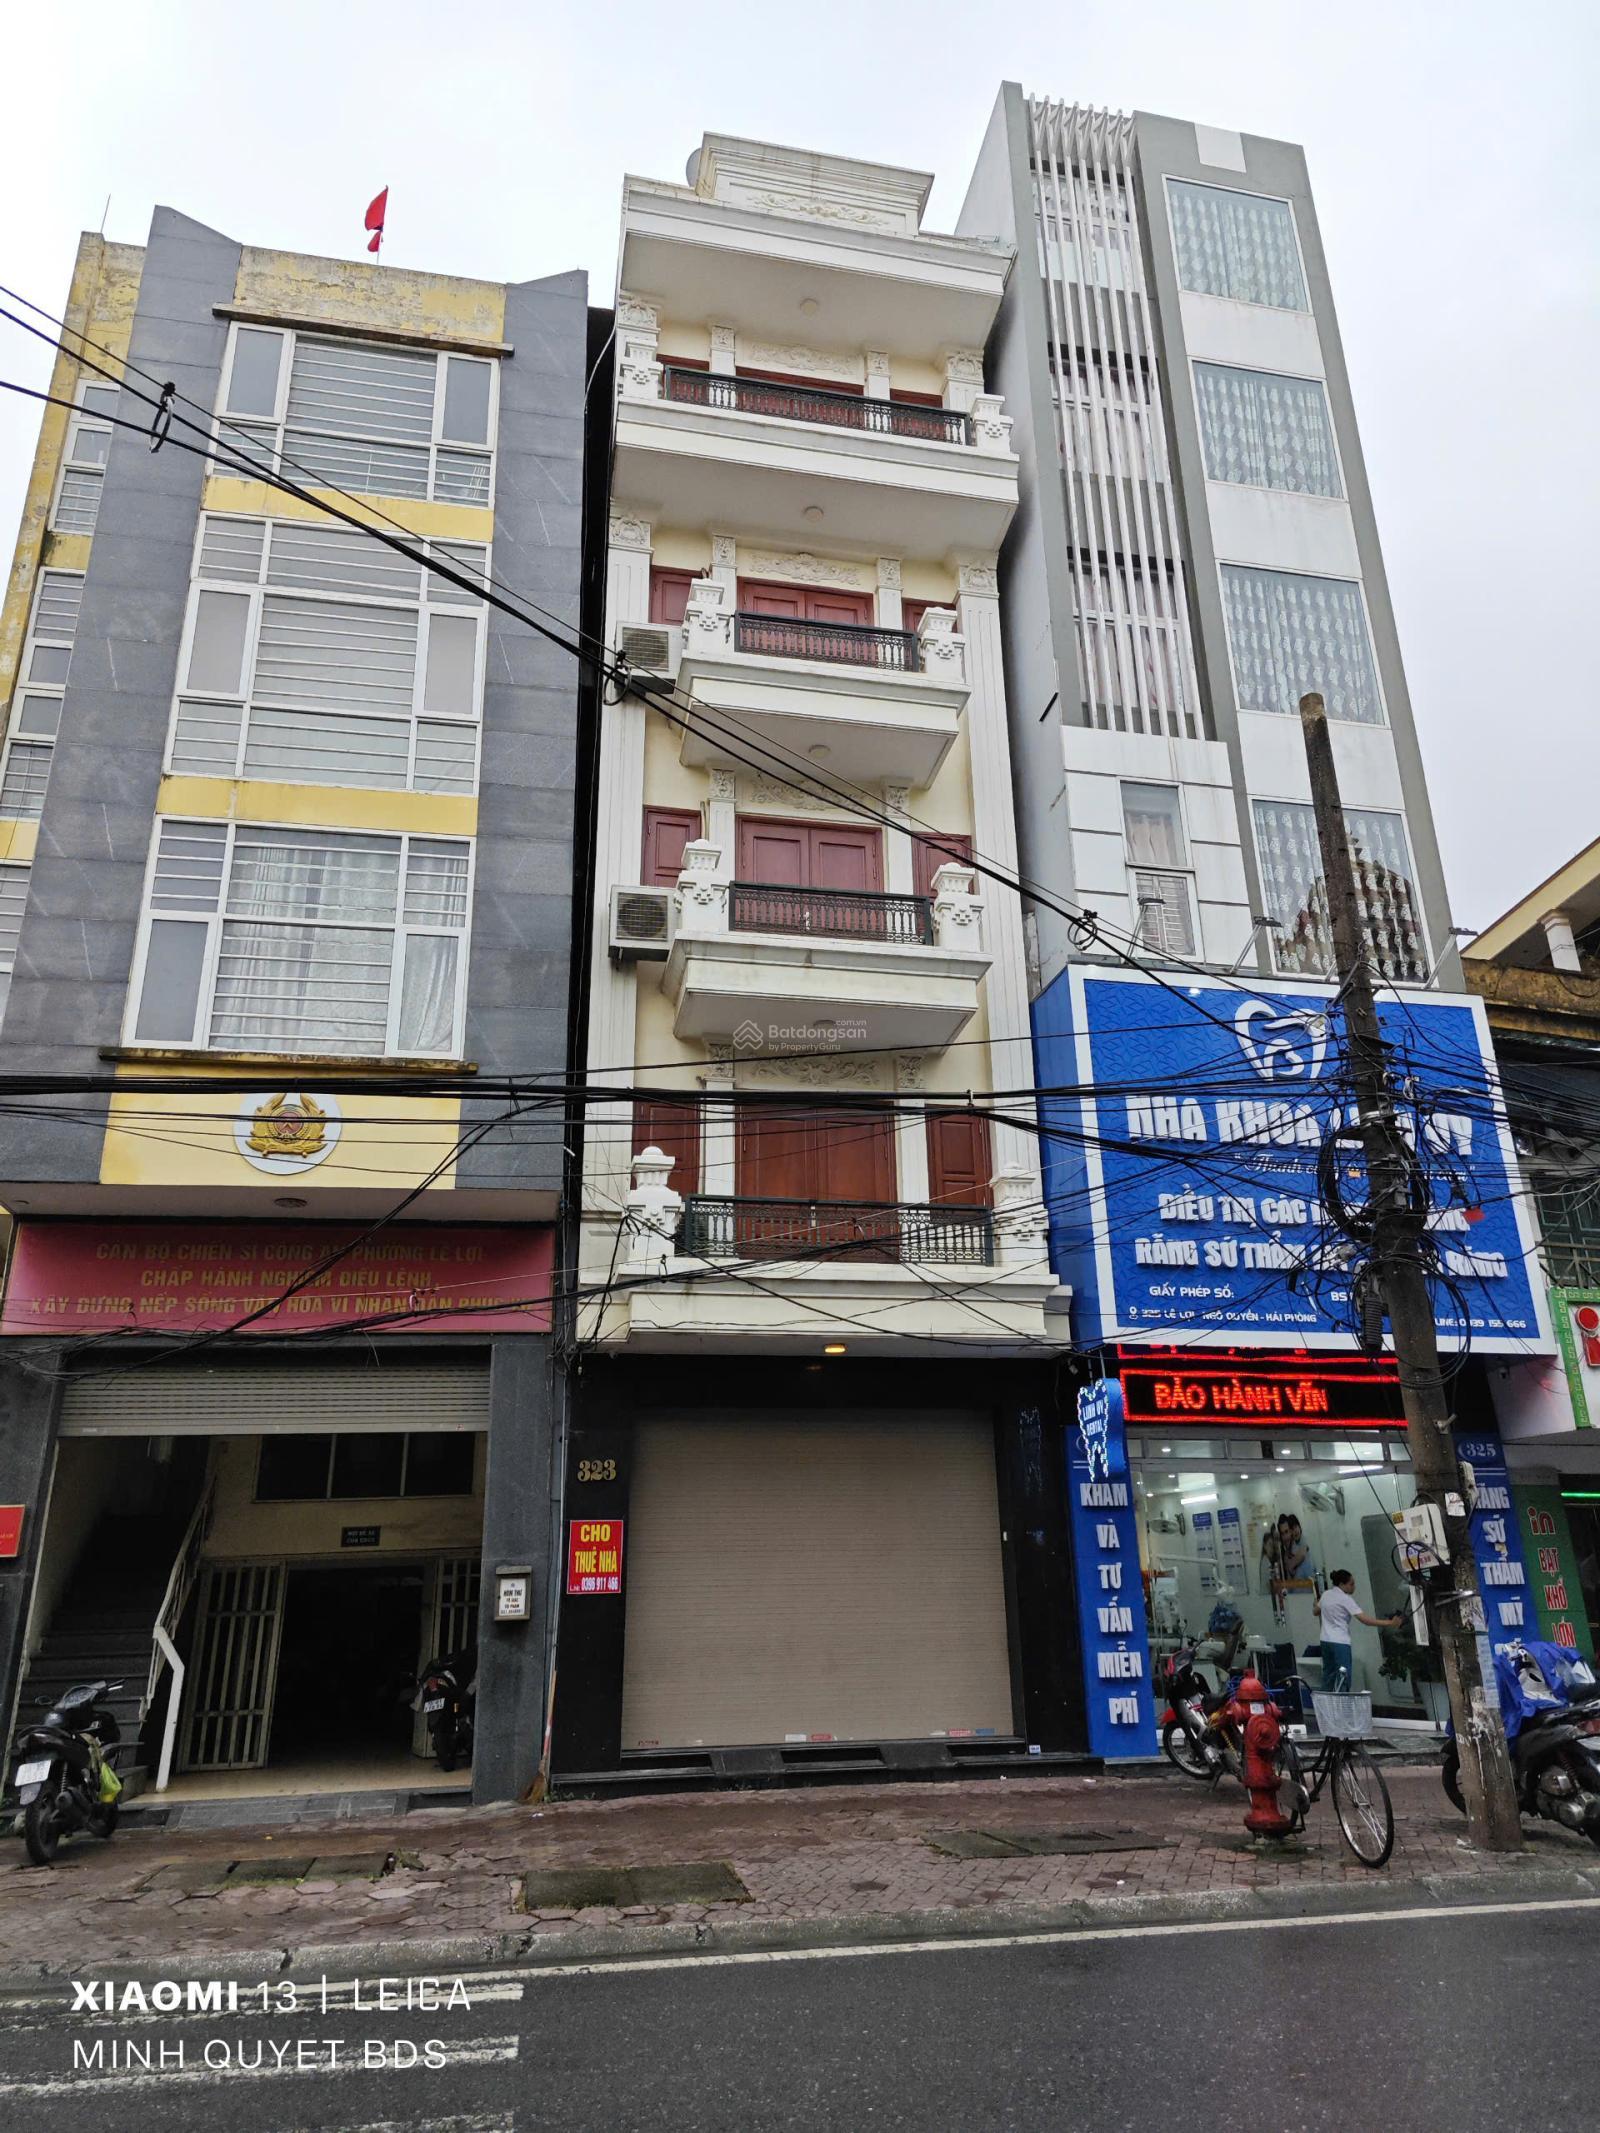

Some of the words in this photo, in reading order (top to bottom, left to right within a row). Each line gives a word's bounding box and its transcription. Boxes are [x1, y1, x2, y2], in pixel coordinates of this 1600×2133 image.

[1125, 1095, 1208, 1142] NHA
[1215, 1099, 1322, 1148] KHOA
[1261, 1194, 1307, 1225] CÁC
[1134, 1233, 1199, 1266] RĂNG
[1203, 1236, 1238, 1268] SỨ
[1445, 1246, 1508, 1278] RĂNG
[200, 1266, 253, 1287] HÀNH
[1149, 1282, 1176, 1297] GIẤY
[1180, 1285, 1211, 1298] PHÉP
[1214, 1283, 1235, 1298] SỐ:
[139, 1291, 178, 1313] NẾP
[1506, 1320, 1527, 1329] 666
[1154, 1376, 1206, 1409] BẢO
[1212, 1378, 1282, 1412] HÀNH
[1086, 1419, 1104, 1437] DENTAL
[1466, 1443, 1496, 1457] 325
[577, 1459, 617, 1482] 323
[580, 1524, 611, 1542] CHO
[1096, 1518, 1120, 1548] VÀ
[1482, 1514, 1507, 1544] SỨ
[1528, 1506, 1556, 1535] in
[575, 1546, 597, 1573] THUÊ
[598, 1546, 618, 1573] NHÀ
[1538, 1548, 1560, 1577] BẠT
[1098, 1562, 1122, 1589] TƯ
[1097, 1596, 1133, 1633] VẤN
[1097, 1641, 1143, 1678] MIỄN
[1108, 1691, 1140, 1724] PHÍ
